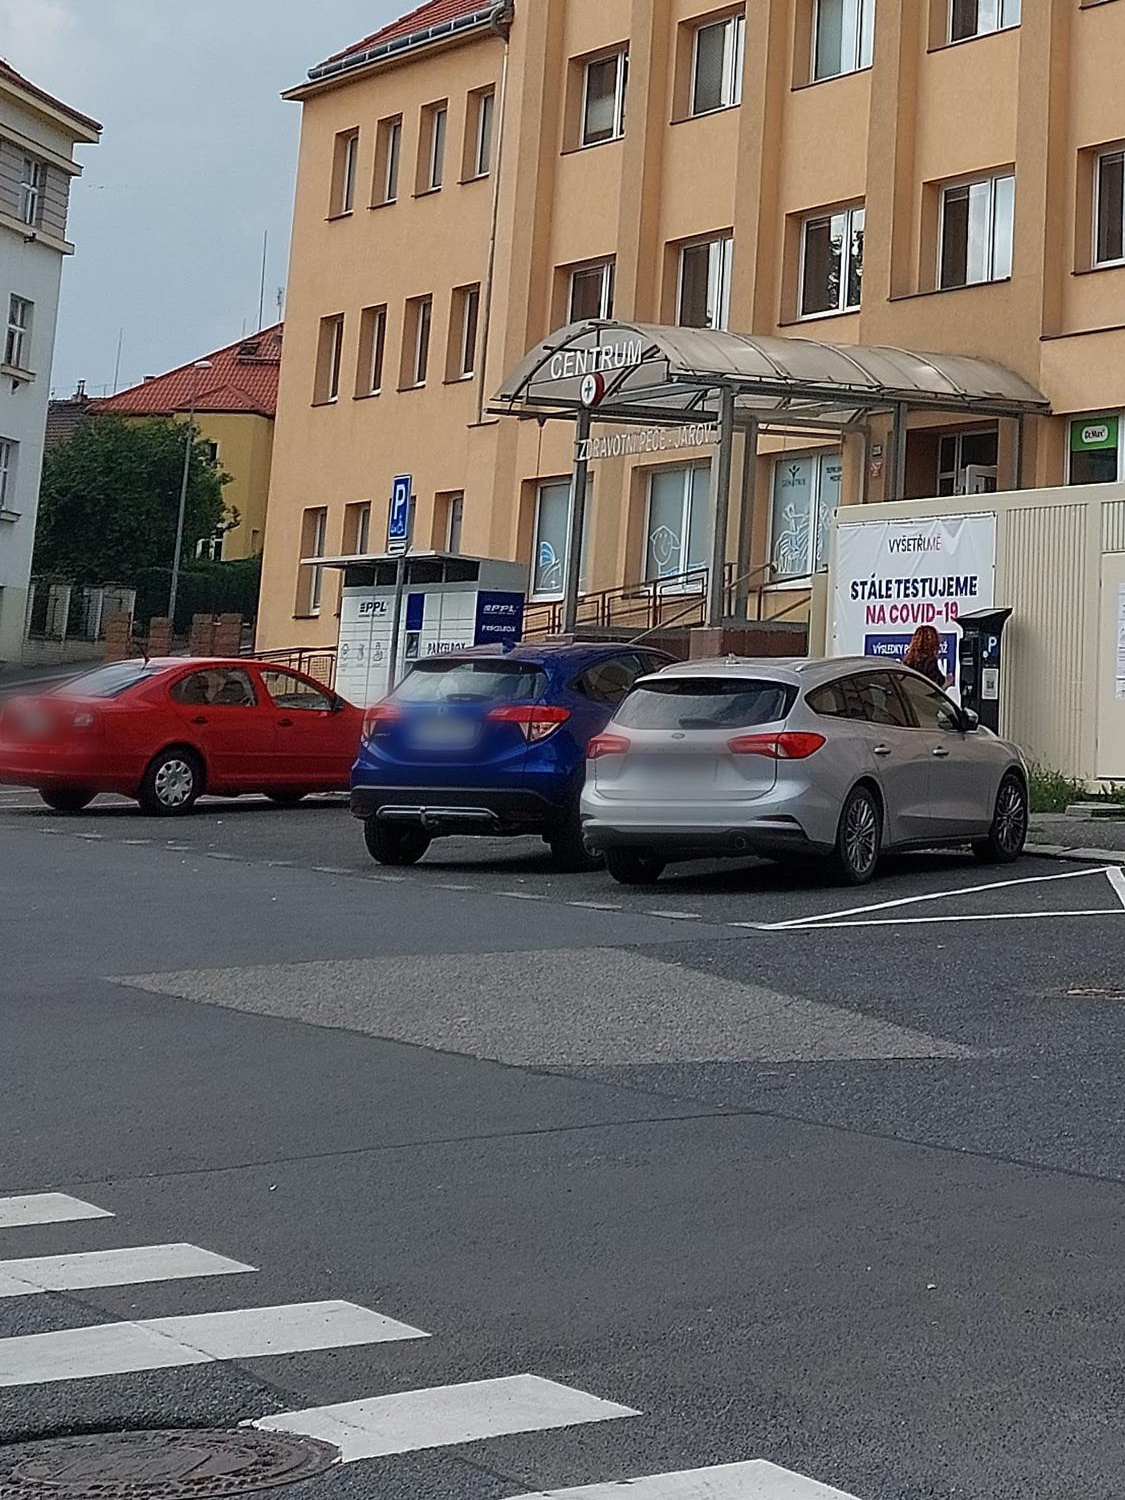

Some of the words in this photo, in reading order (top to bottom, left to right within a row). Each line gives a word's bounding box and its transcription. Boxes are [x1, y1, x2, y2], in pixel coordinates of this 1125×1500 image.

[550, 339, 643, 379] CENTRUM
[394, 484, 406, 520] P
[850, 573, 893, 600] STÁLE
[895, 576, 978, 598] TESTUJEME
[366, 601, 387, 612] PPL
[866, 604, 886, 625] NA
[889, 601, 959, 624] COVID-19
